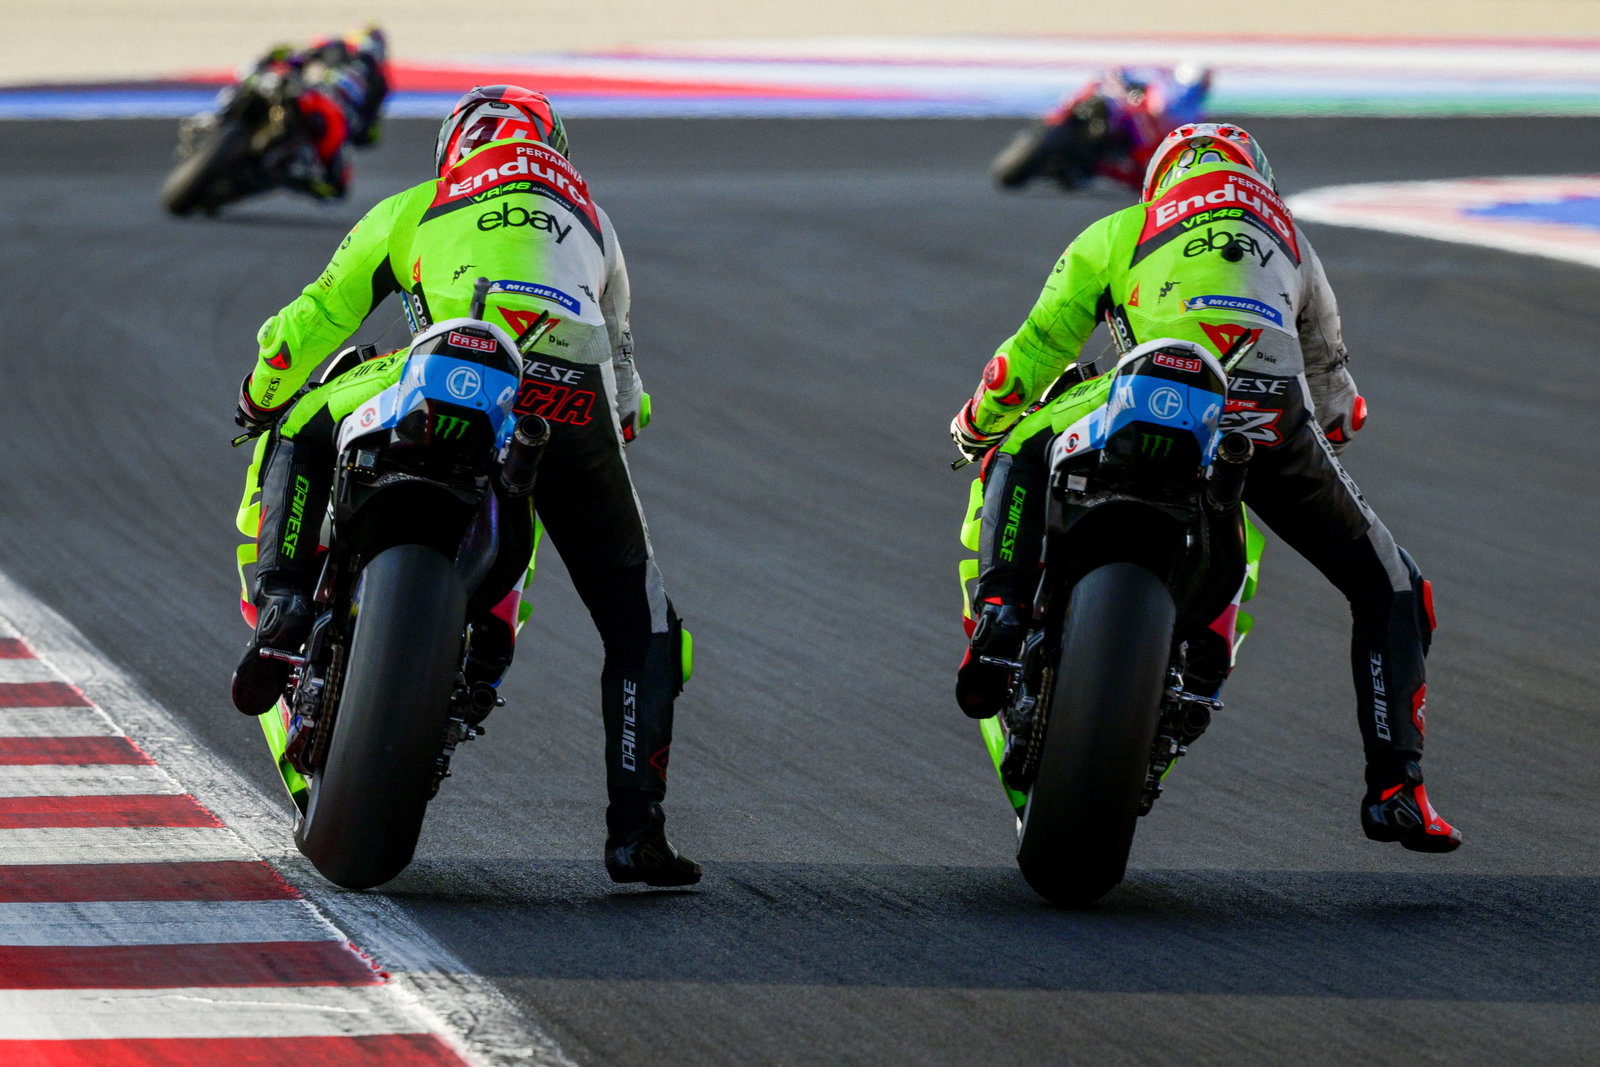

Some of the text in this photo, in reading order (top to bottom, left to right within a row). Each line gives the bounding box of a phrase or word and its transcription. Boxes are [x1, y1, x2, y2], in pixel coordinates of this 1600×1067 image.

[449, 156, 588, 206] Enduro
[516, 146, 584, 184] PERTAMINA
[1155, 184, 1291, 238] Enduro
[1228, 175, 1293, 220] PERTAMINA
[477, 202, 572, 244] ebay
[1183, 228, 1274, 268] ebay
[506, 283, 573, 307] MICHELIN
[1208, 298, 1276, 318] MICHELIN
[452, 335, 494, 350] FASSI
[1157, 354, 1199, 370] FASSI
[282, 474, 310, 560] DAINESE
[1000, 485, 1027, 562] DAINESE
[1370, 650, 1392, 742] DAINESE
[622, 678, 637, 772] DAINESE
